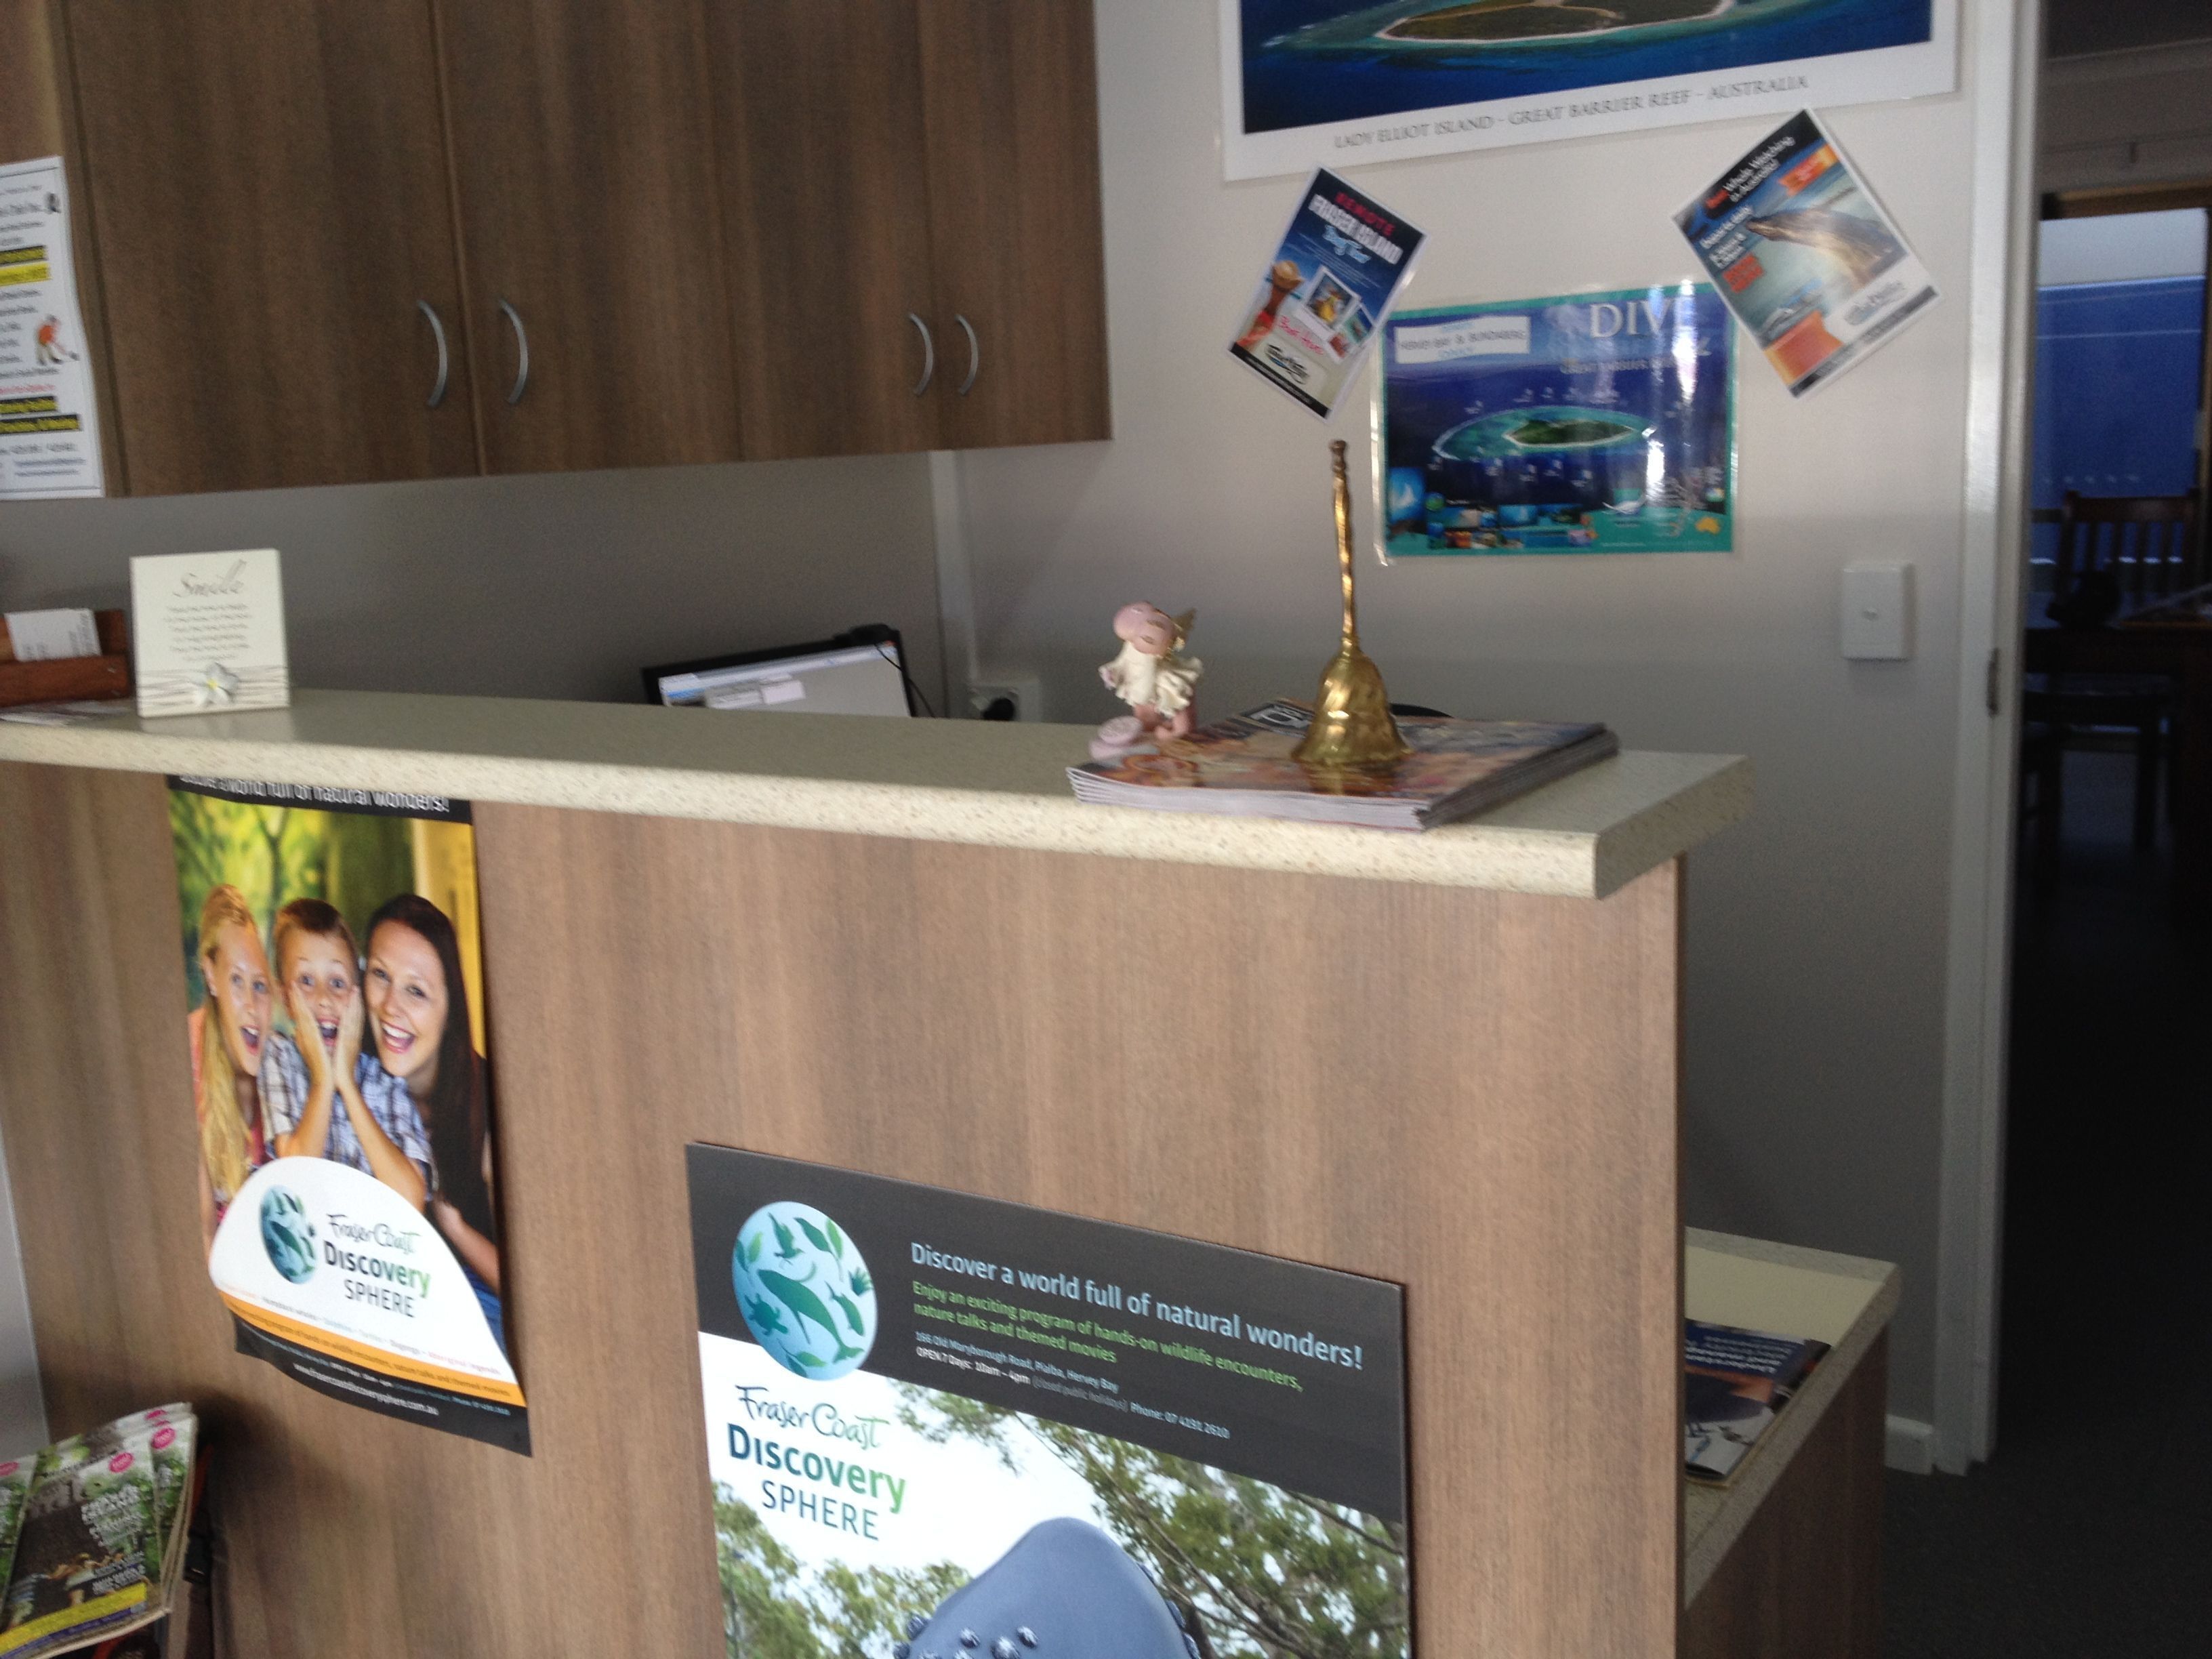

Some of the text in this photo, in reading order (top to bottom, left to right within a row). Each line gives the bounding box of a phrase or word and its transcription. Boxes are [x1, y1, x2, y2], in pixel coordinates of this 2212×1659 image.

[1334, 133, 1373, 148] LADY
[1434, 116, 1494, 136] ISLAND
[1509, 106, 1566, 125] GREAT
[1569, 96, 1643, 118] BARRIER
[1648, 89, 1692, 107] REEF
[1707, 75, 1810, 100] AUSTRALIA
[344, 1278, 415, 1318] SPHERE
[911, 1242, 1364, 1371] Discover a world full of natural wonders!
[912, 1279, 947, 1304] Enjoy
[949, 1291, 965, 1305] an
[966, 1295, 1018, 1322] exciting
[1019, 1308, 1076, 1332] program
[1077, 1321, 1092, 1336] of
[1094, 1322, 1159, 1353] hands-on
[1214, 1355, 1304, 1393] encounters,
[913, 1303, 1117, 1364] nature talks and themed movies
[916, 1345, 943, 1361] OPEN
[735, 1384, 890, 1450] Fraser Coast
[760, 1479, 880, 1542] SPHERE
